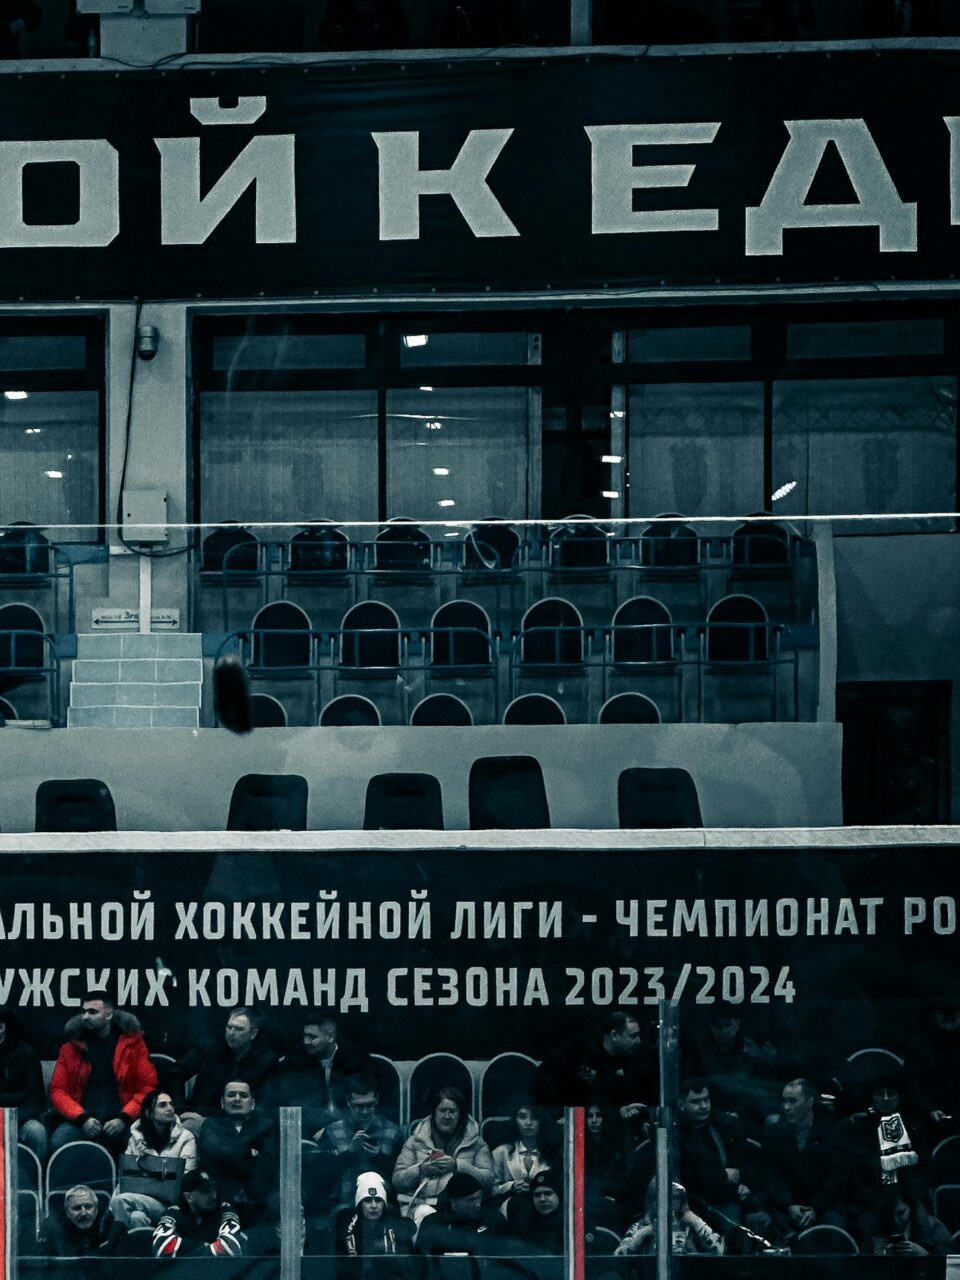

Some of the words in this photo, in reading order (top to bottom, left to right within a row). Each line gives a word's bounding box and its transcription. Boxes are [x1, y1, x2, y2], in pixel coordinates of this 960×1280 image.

[371, 128, 520, 241] К
[584, 116, 960, 256] ЕД
[175, 890, 431, 940] ХОККЕЙНОЙ
[451, 901, 563, 939] ЛИГИ
[616, 897, 884, 938] ЧЕМПИОНАТ
[188, 967, 369, 1013] КОМАНД
[387, 966, 549, 1006] СЕЗОНА
[565, 963, 797, 1007] 2023/2024
